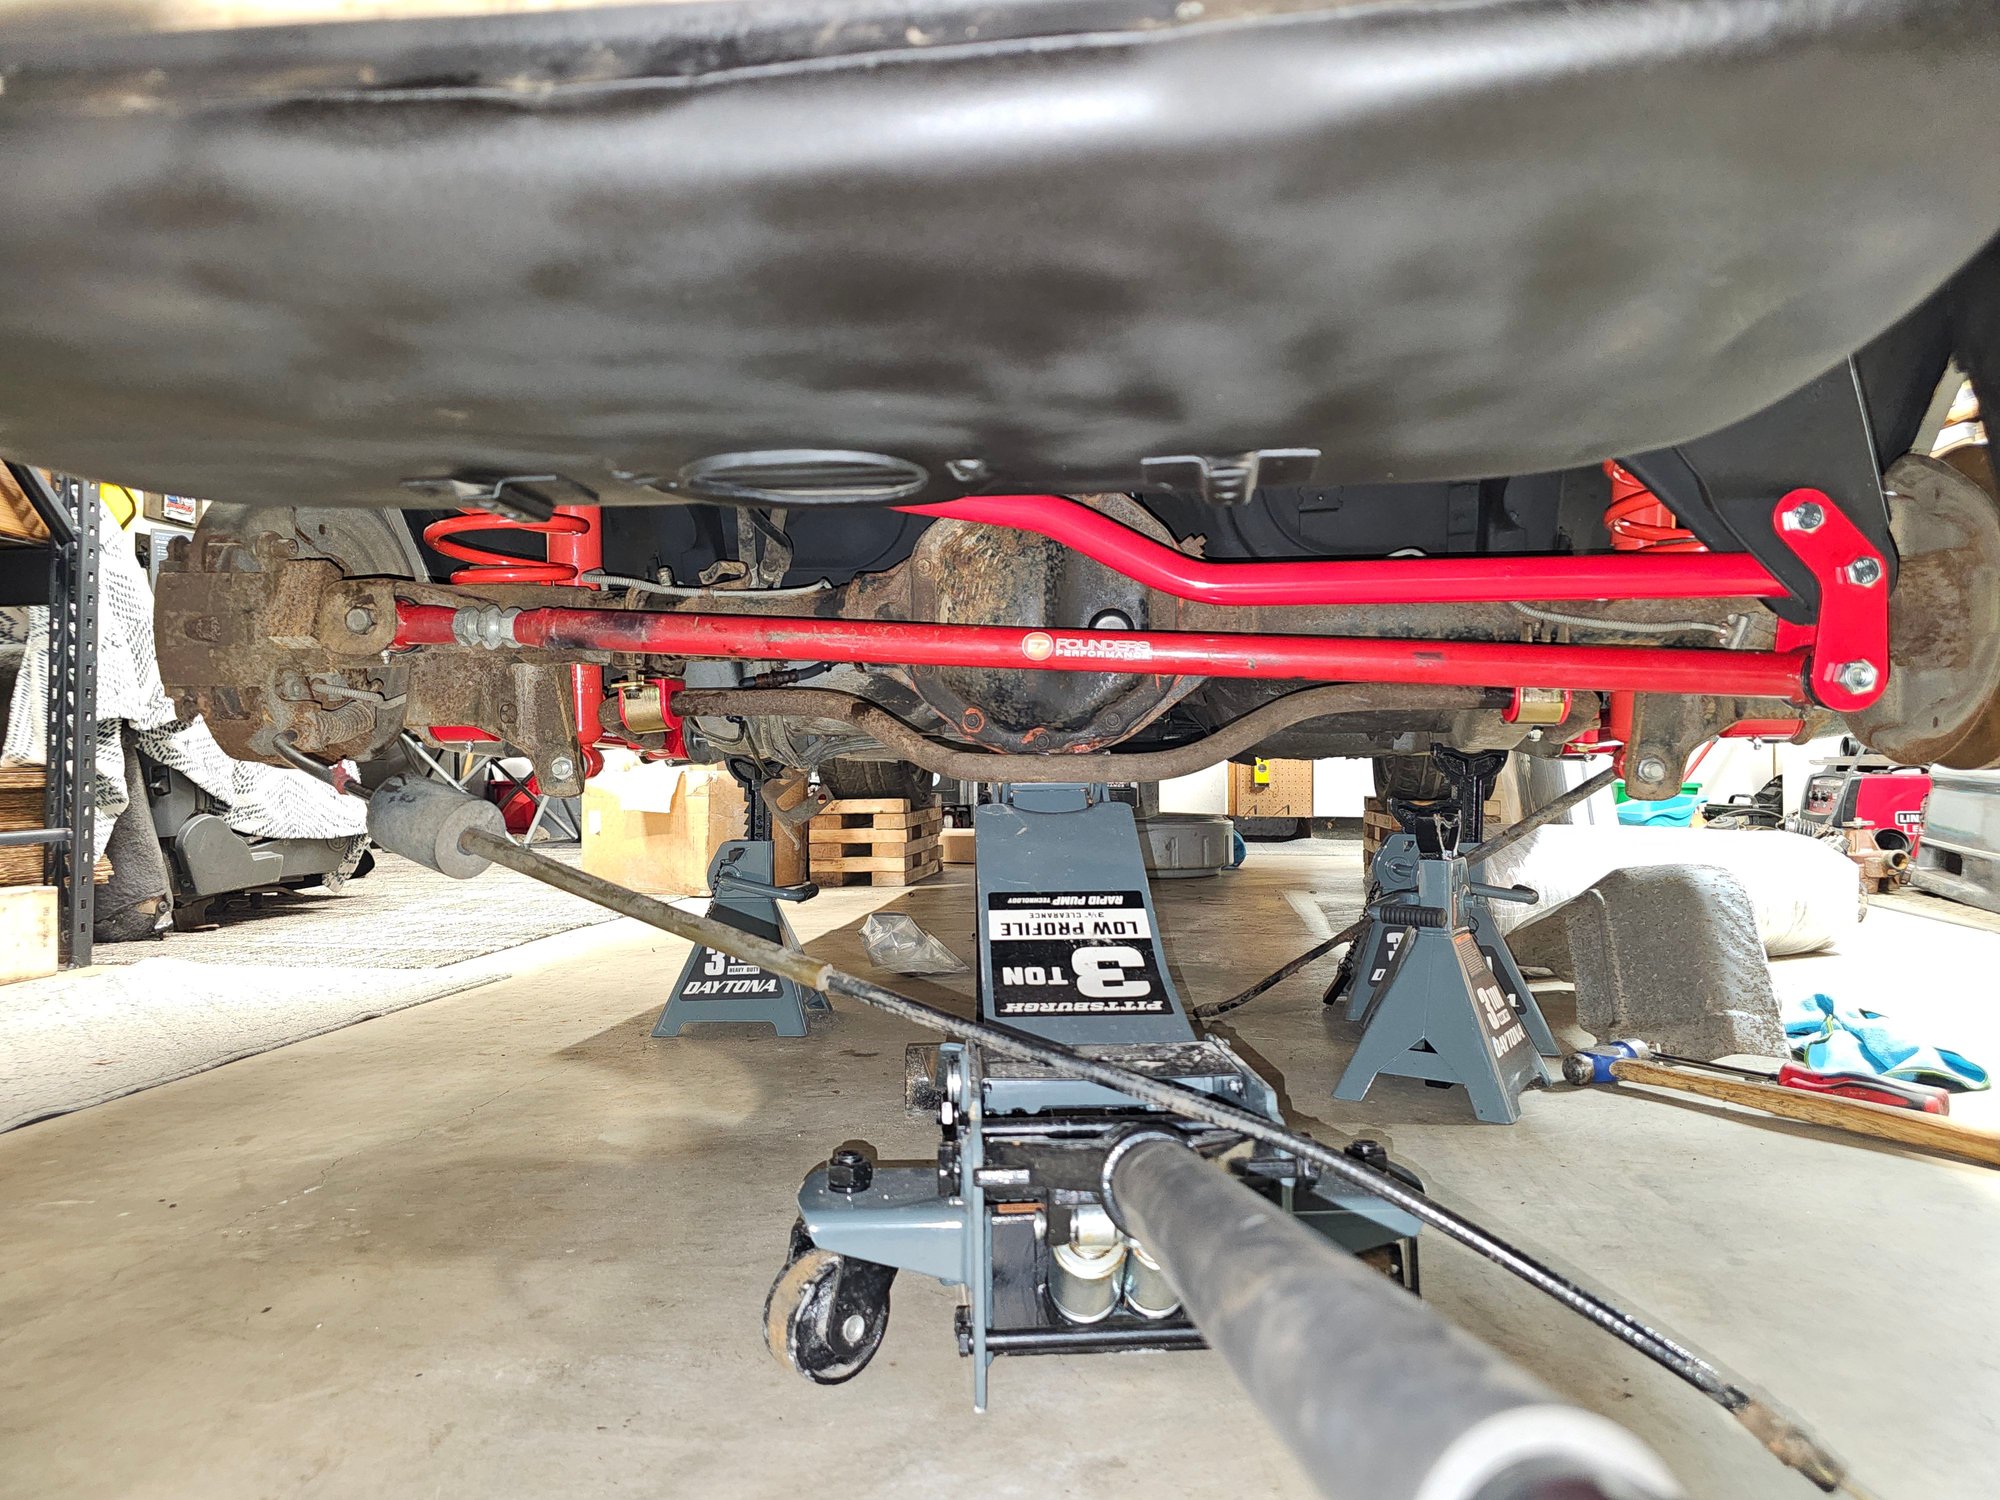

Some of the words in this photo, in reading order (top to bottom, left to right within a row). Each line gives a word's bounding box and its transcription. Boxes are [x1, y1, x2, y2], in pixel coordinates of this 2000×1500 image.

[1056, 638, 1150, 651] FOUNDERS
[1900, 814, 1920, 823] LIN
[1052, 896, 1086, 906] PUMP
[1088, 895, 1124, 905] RAPID
[1001, 922, 1084, 936] PROFILE
[1093, 921, 1138, 935] LOW
[704, 946, 726, 976] 3
[1002, 966, 1069, 986] TON
[1071, 946, 1151, 998] 3
[682, 979, 778, 995] DAYTONA
[1003, 1000, 1163, 1013] PITTSBURGH
[1477, 987, 1500, 1030] 3
[1492, 1023, 1526, 1059] DAYTONA
